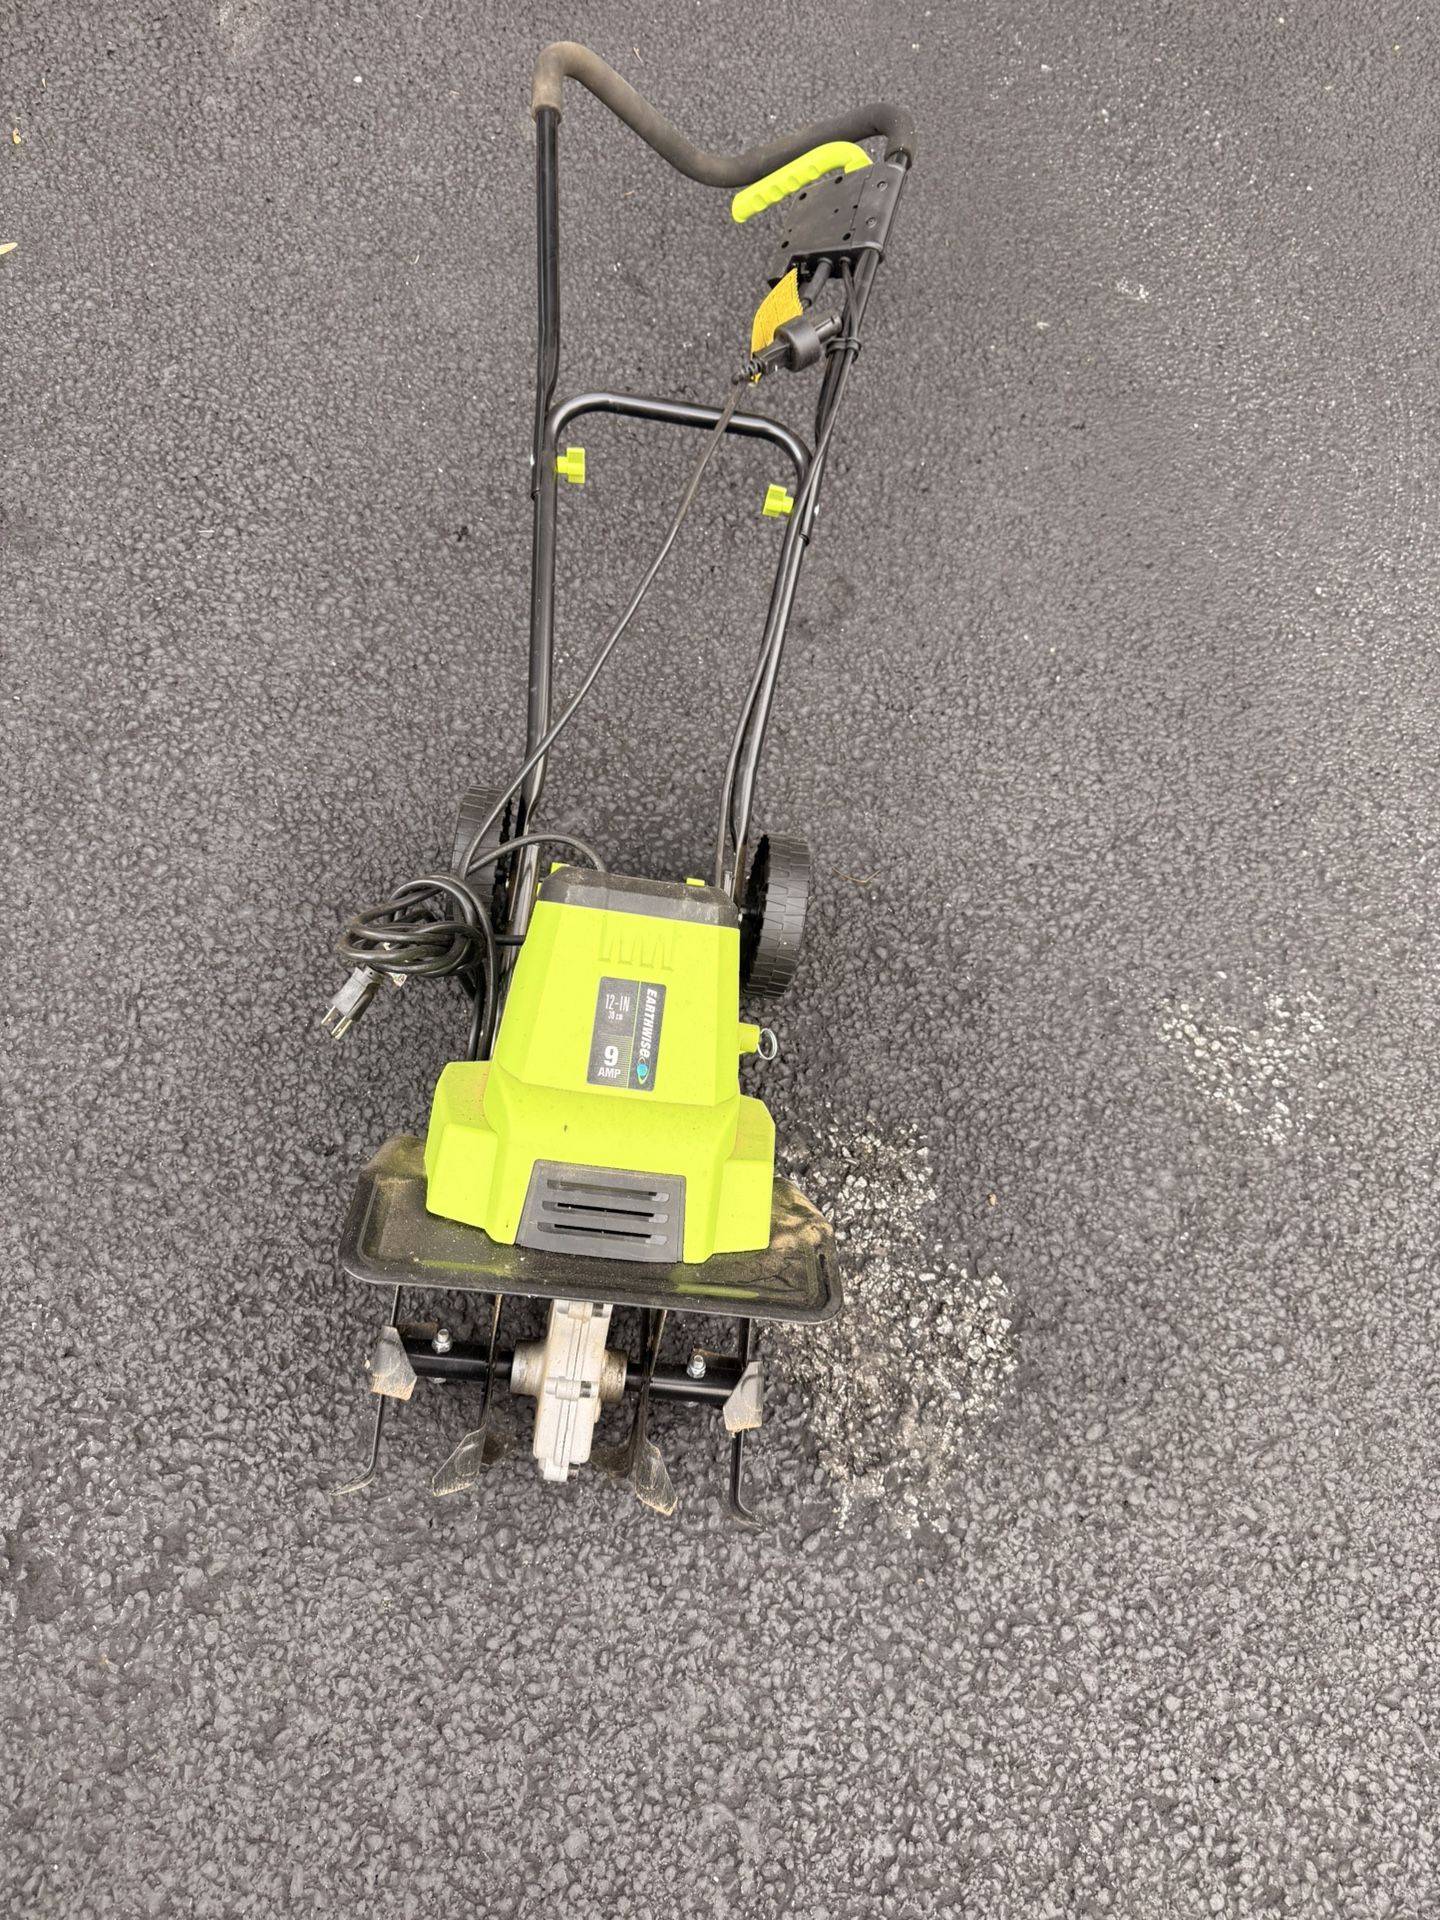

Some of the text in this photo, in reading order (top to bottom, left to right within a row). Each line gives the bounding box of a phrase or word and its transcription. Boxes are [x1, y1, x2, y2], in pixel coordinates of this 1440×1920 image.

[605, 994, 630, 1012] 12-IN
[603, 1045, 619, 1067] 9
[598, 1067, 621, 1079] AMP
